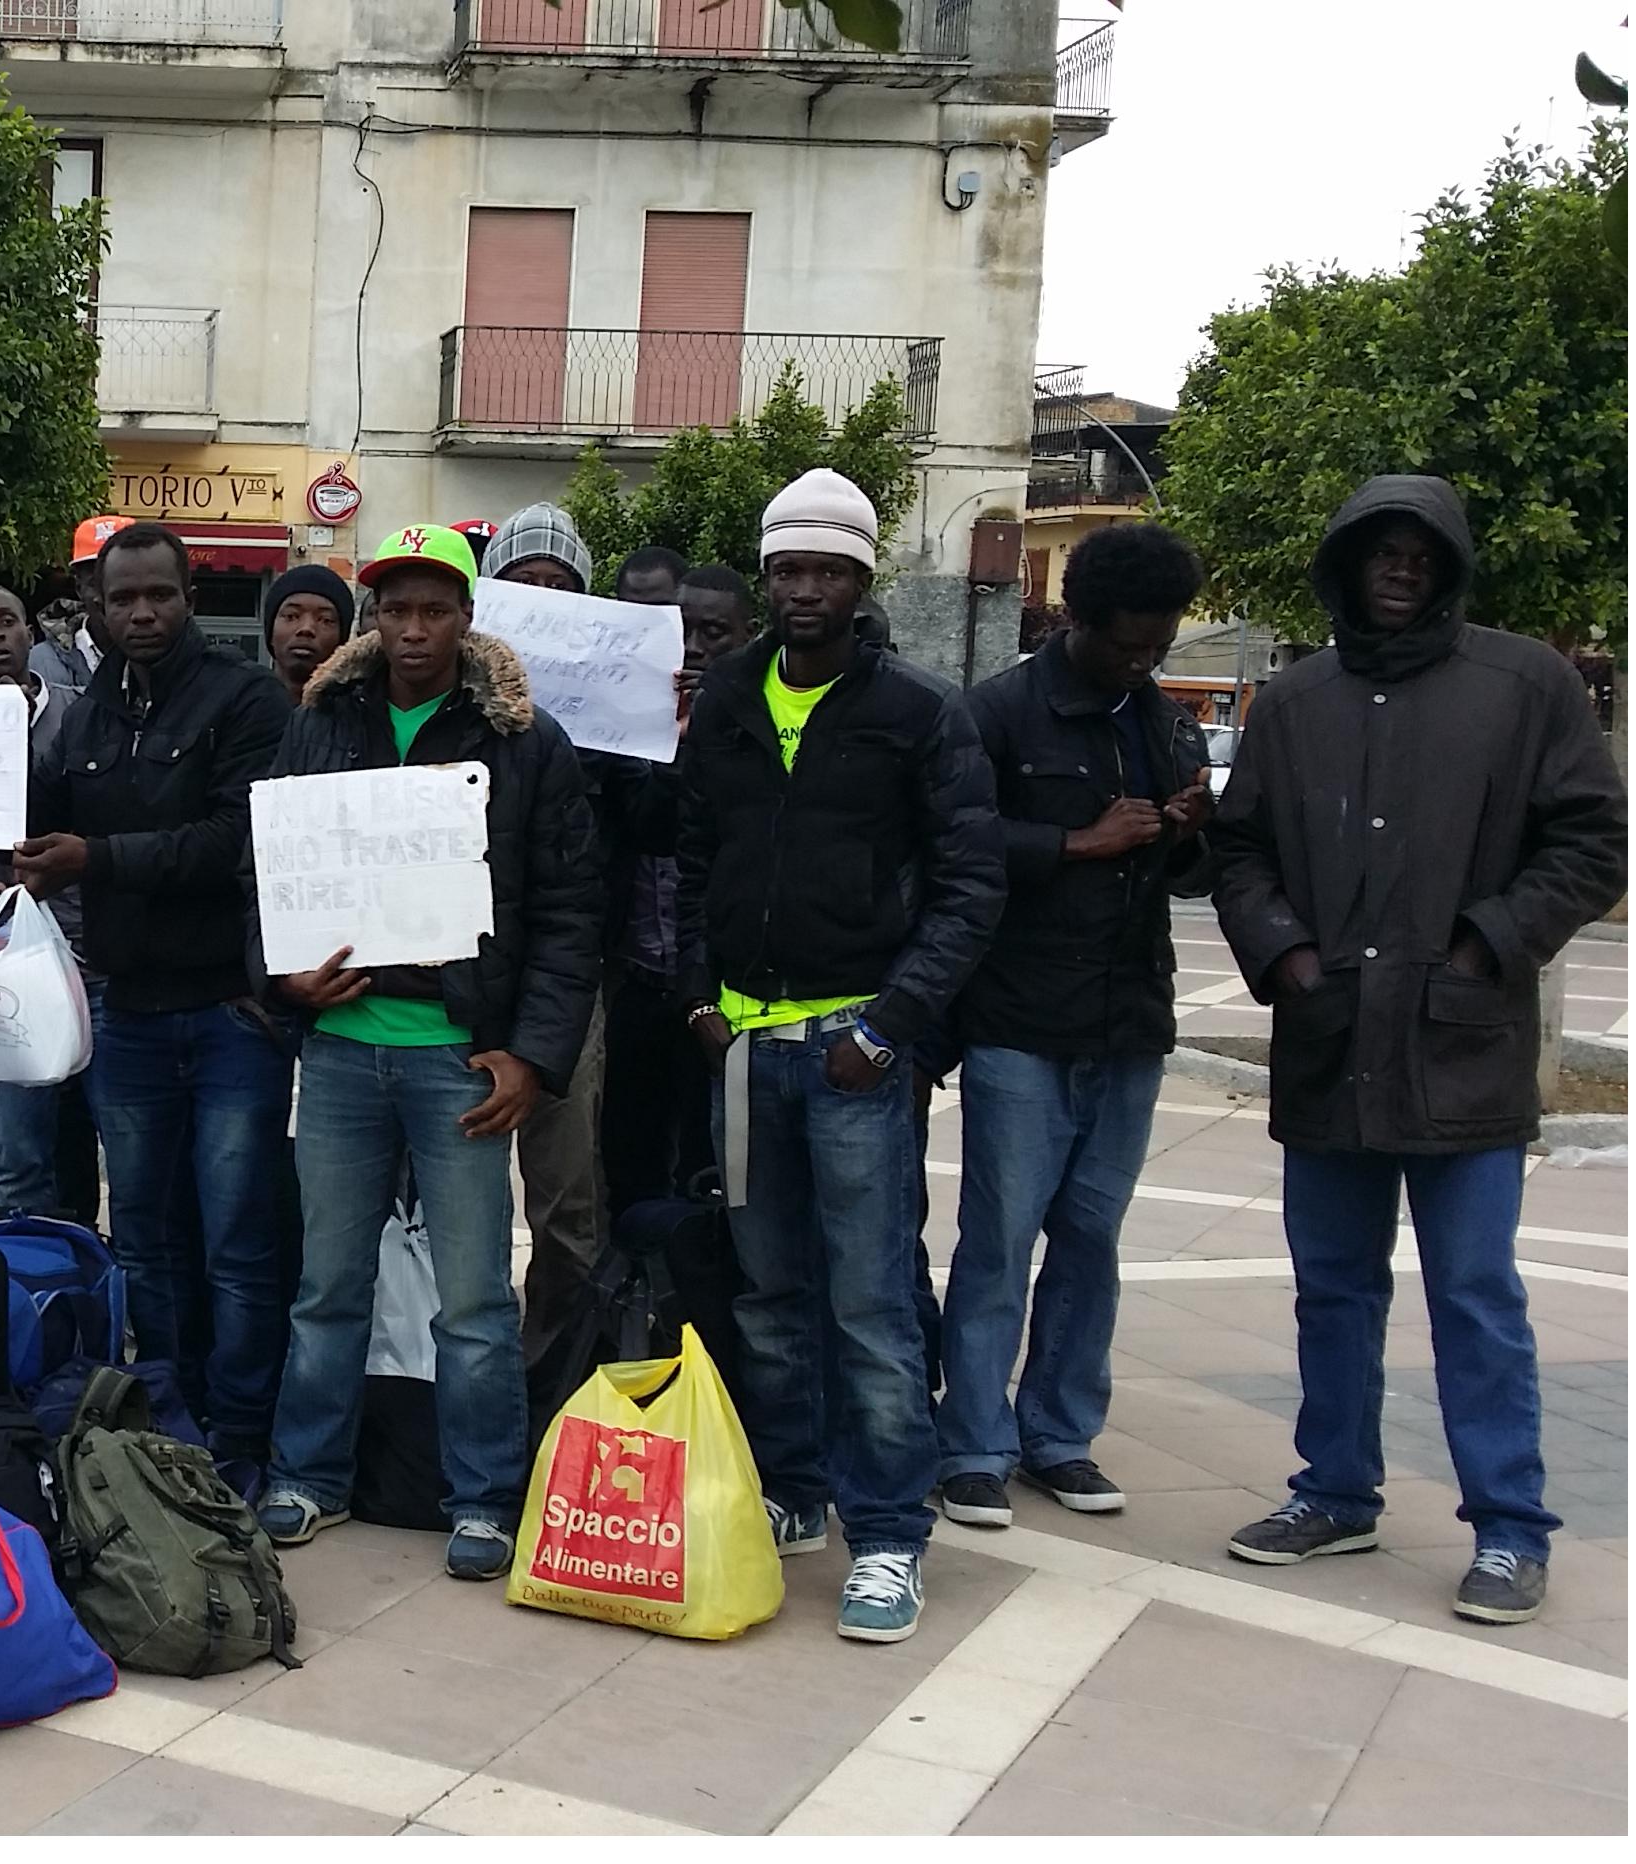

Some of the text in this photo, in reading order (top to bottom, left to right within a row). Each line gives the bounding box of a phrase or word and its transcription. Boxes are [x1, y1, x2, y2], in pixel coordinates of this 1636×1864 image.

[108, 474, 212, 507] TORIO
[398, 528, 431, 553] NY
[544, 1494, 682, 1548] Spaccio
[539, 1543, 680, 1589] Alimentare
[522, 1585, 688, 1629] Dalla tua parte!
